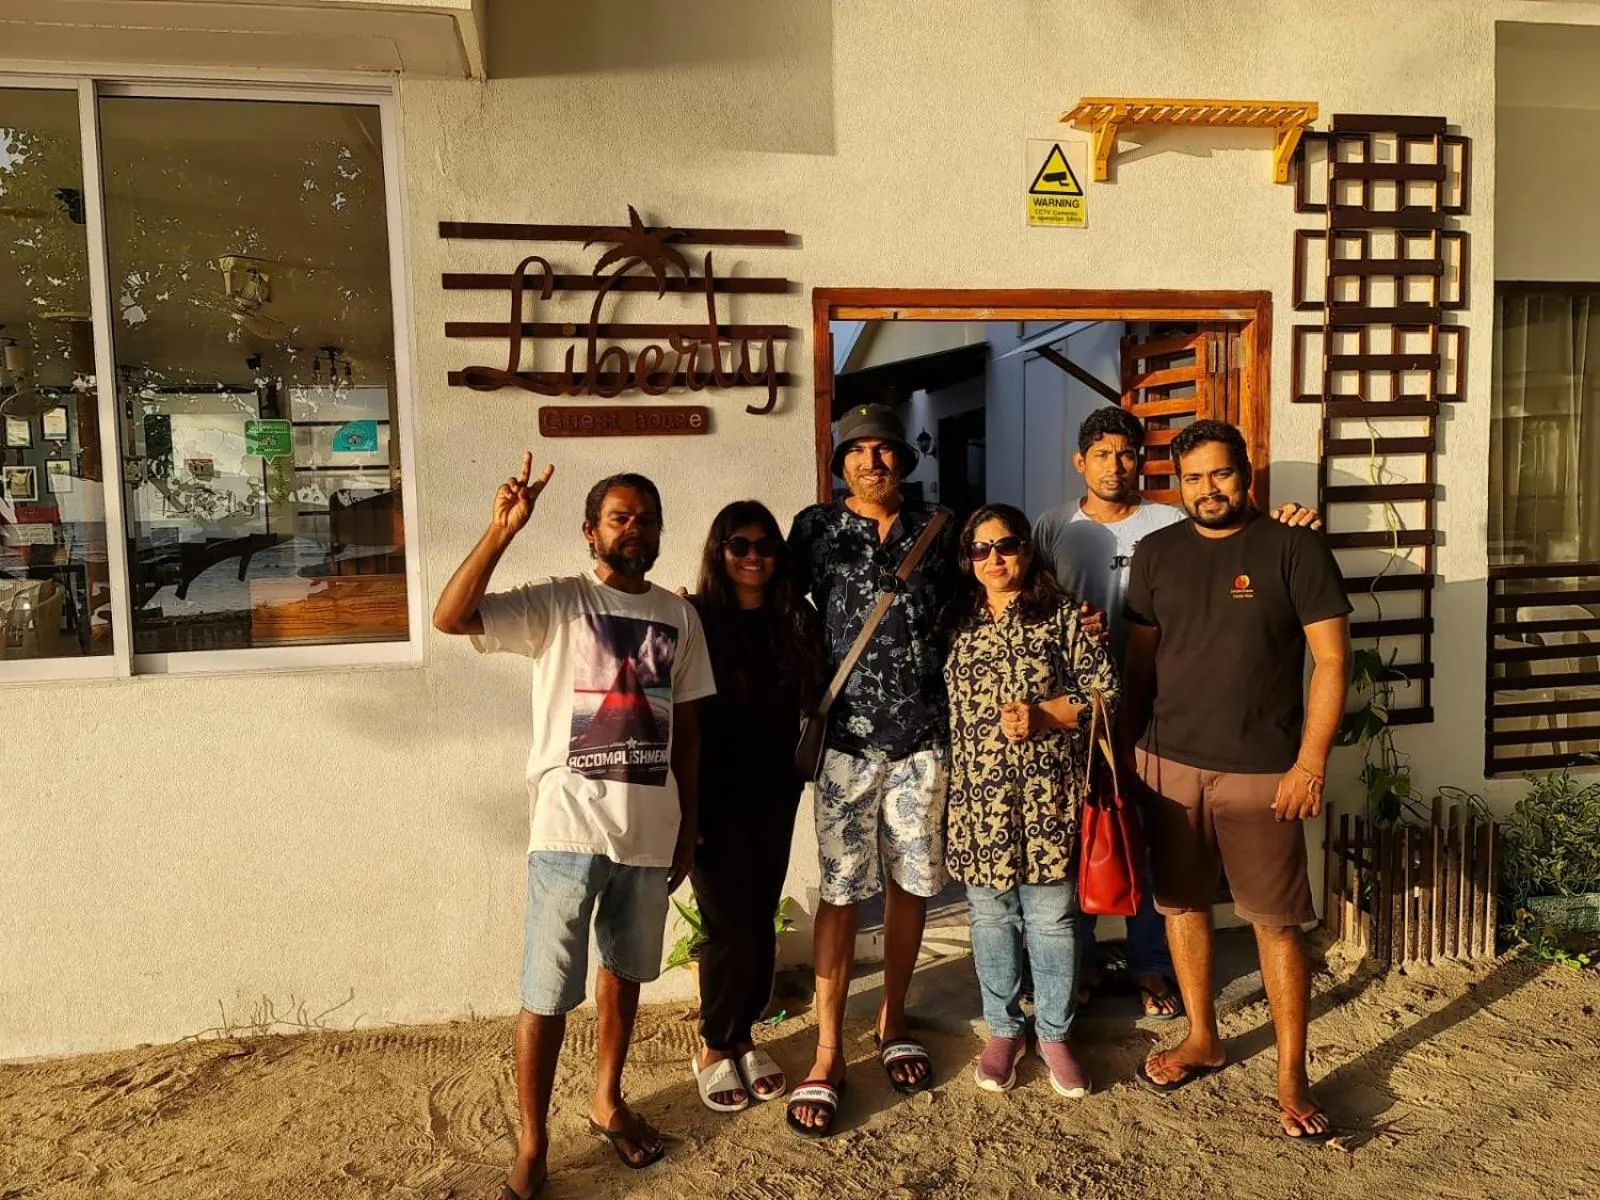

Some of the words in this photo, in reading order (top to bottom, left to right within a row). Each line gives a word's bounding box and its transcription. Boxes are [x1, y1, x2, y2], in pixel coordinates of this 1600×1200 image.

[1033, 197, 1080, 208] WARNING
[461, 250, 778, 416] Liberty
[633, 408, 703, 429] house
